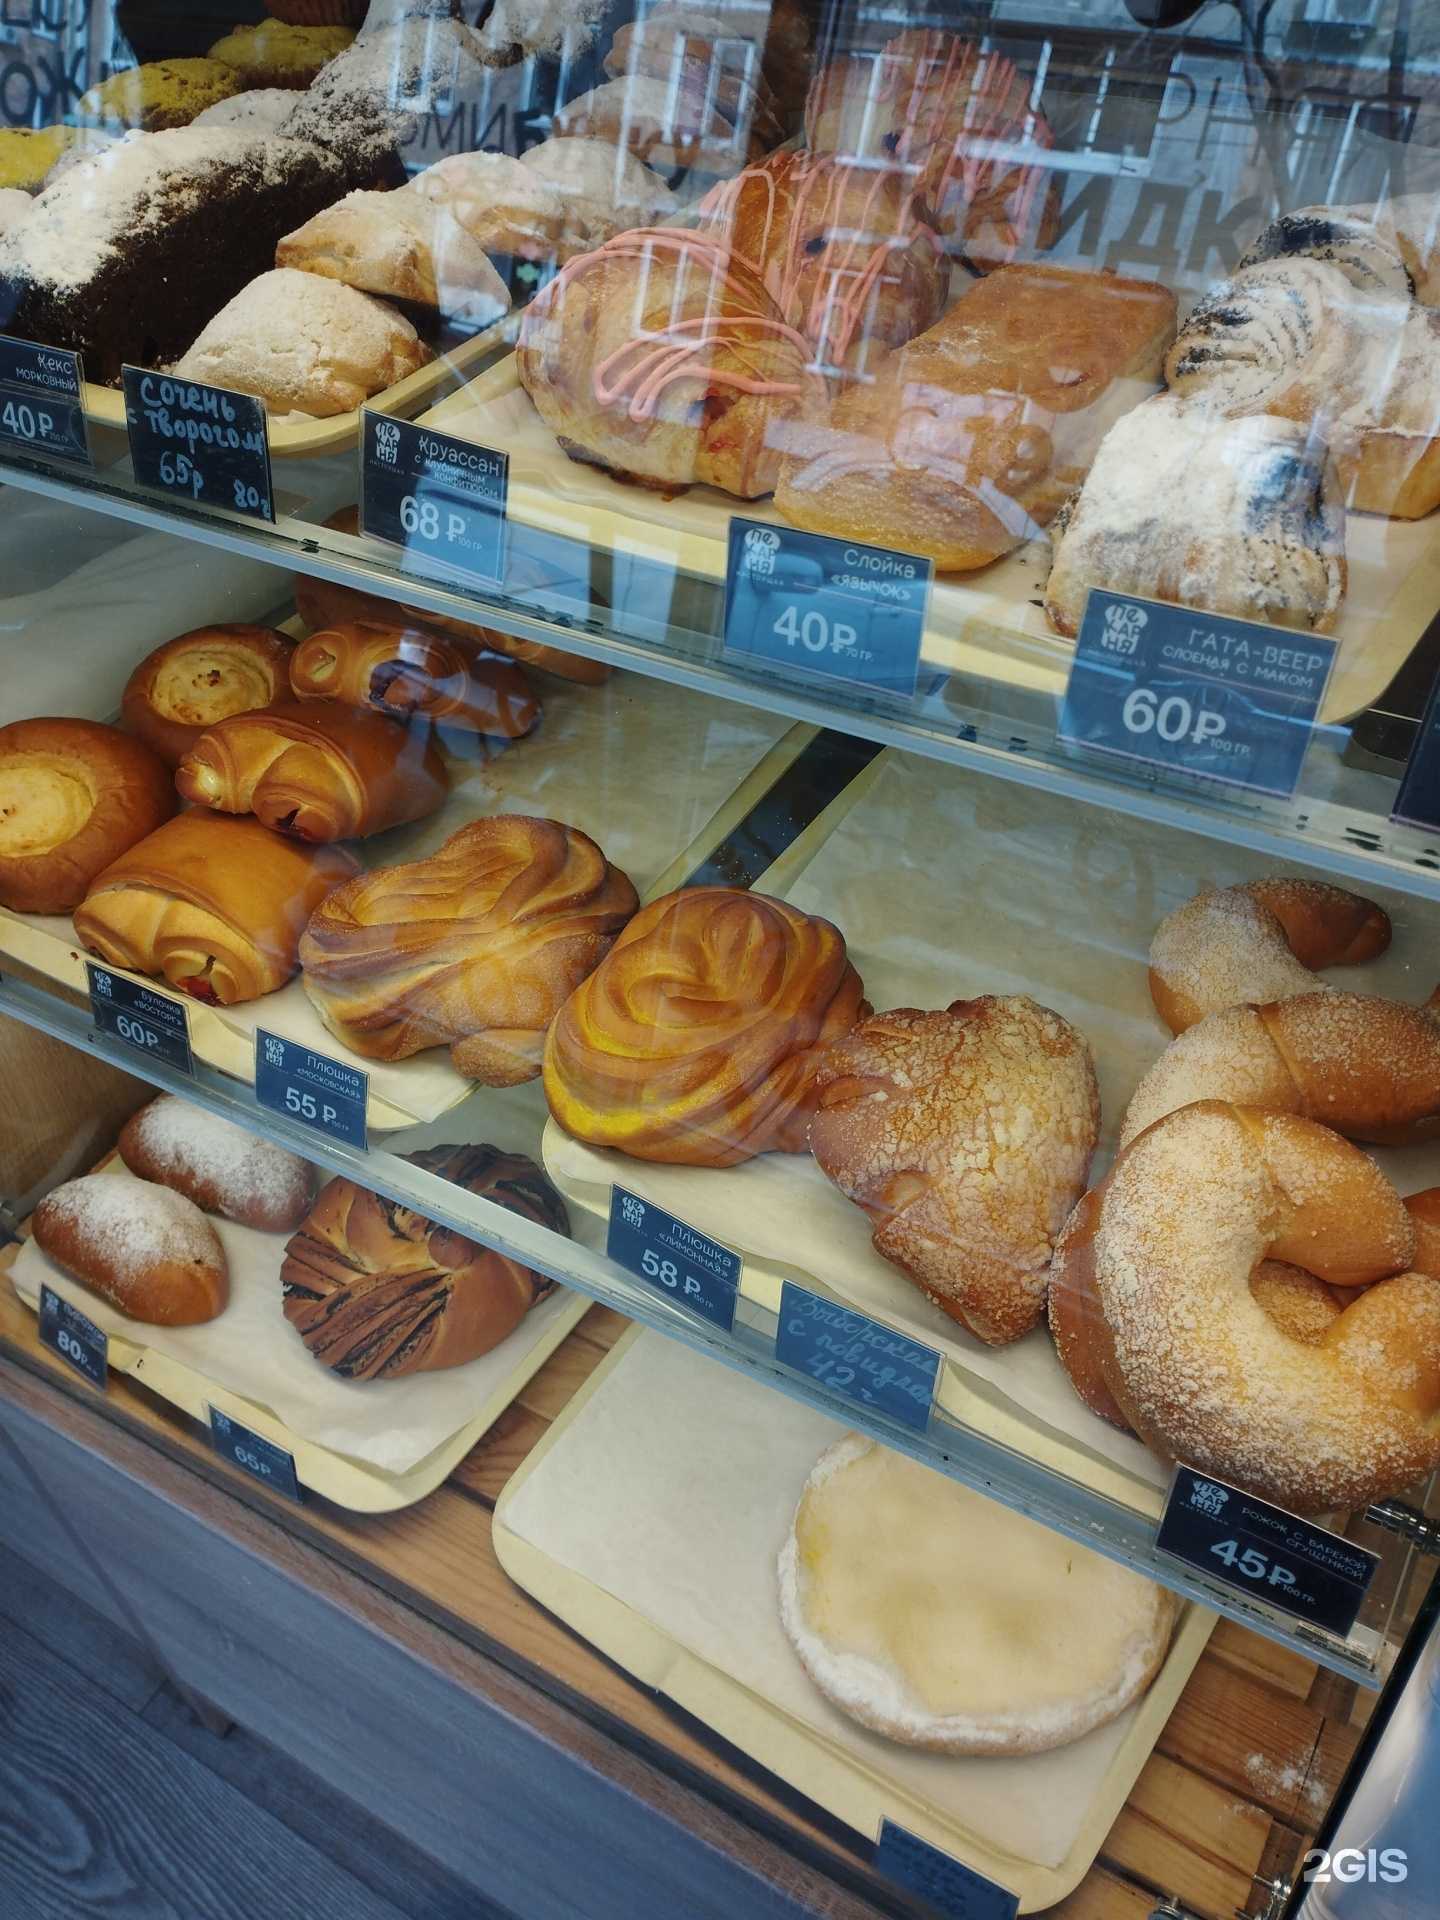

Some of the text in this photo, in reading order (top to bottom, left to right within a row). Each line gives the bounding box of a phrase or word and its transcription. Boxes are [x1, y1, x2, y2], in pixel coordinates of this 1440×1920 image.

[37, 353, 72, 375] Кекс
[419, 434, 499, 477] Круассан
[400, 495, 440, 541] 68
[843, 548, 916, 580] Слойка
[1162, 645, 1230, 670] СЛОЕНАЯ
[1254, 665, 1314, 688] МАКОМ
[1188, 628, 1324, 672] ГАТА-ВЕЕР
[307, 1055, 360, 1087] Плюшка
[285, 1086, 317, 1120] 55
[672, 1223, 732, 1268] Плюшка
[640, 1248, 678, 1288] 58
[1241, 1507, 1289, 1534] РОЖОК
